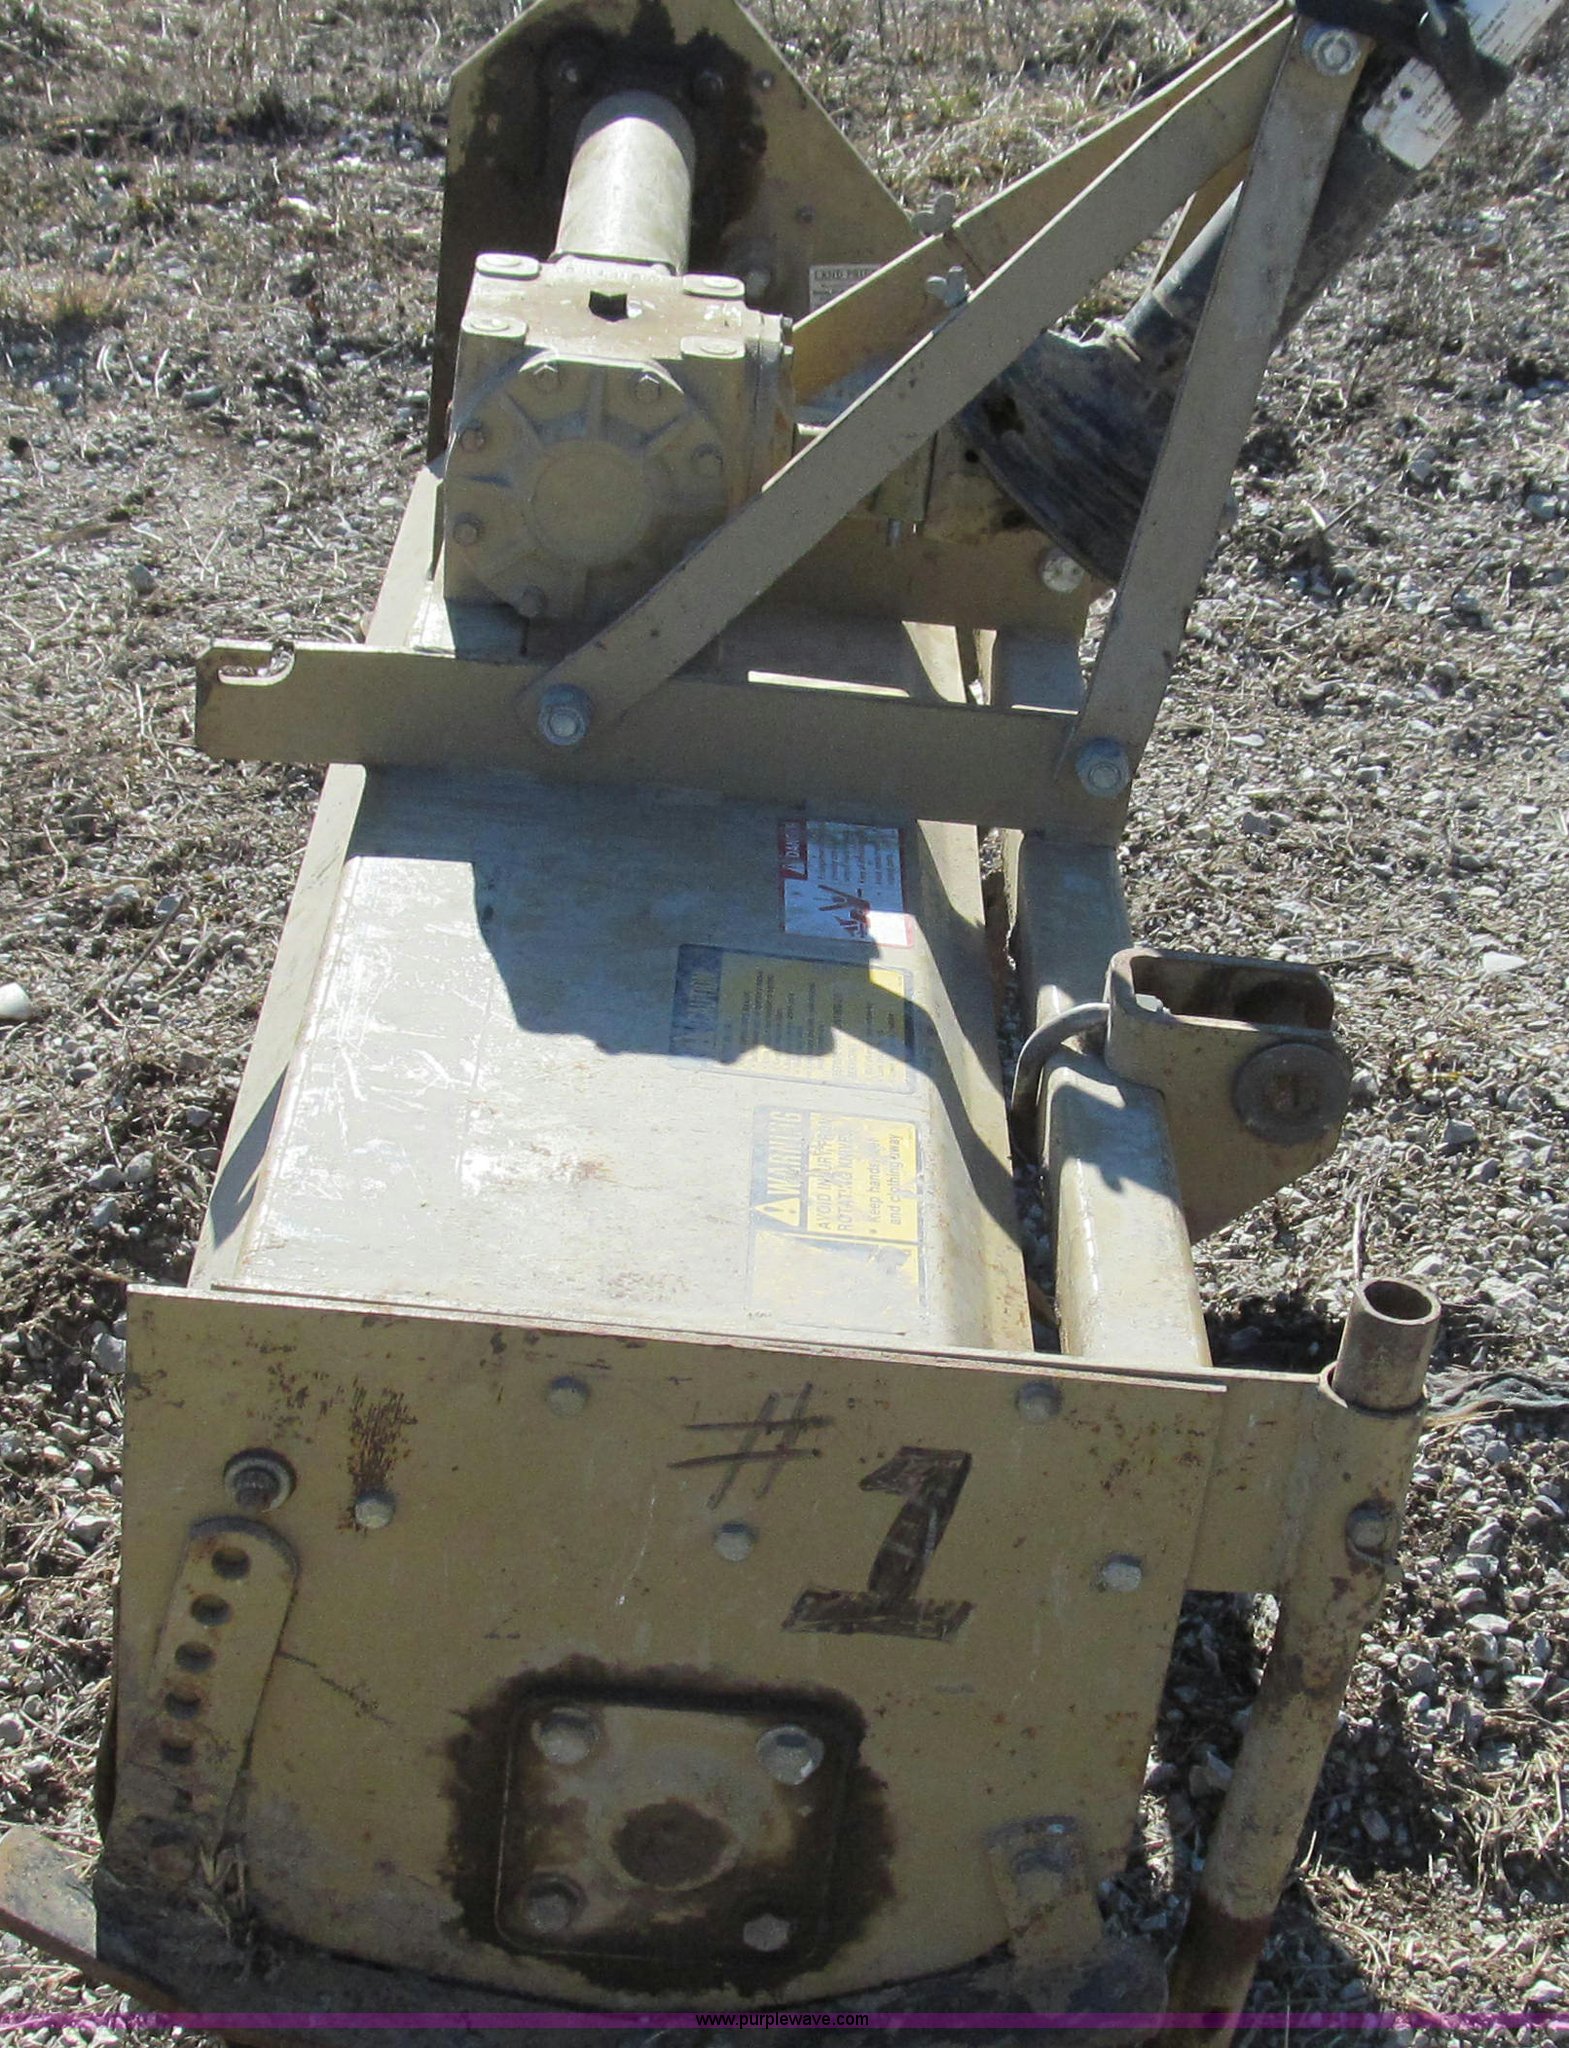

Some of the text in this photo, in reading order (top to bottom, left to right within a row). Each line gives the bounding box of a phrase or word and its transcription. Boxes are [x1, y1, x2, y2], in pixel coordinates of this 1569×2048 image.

[766, 1111, 802, 1195] WARNING
[816, 1150, 833, 1190] INURY
[887, 1133, 904, 1226] and clothing away
[817, 1193, 832, 1230] AVOID
[867, 1197, 883, 1223] Keep
